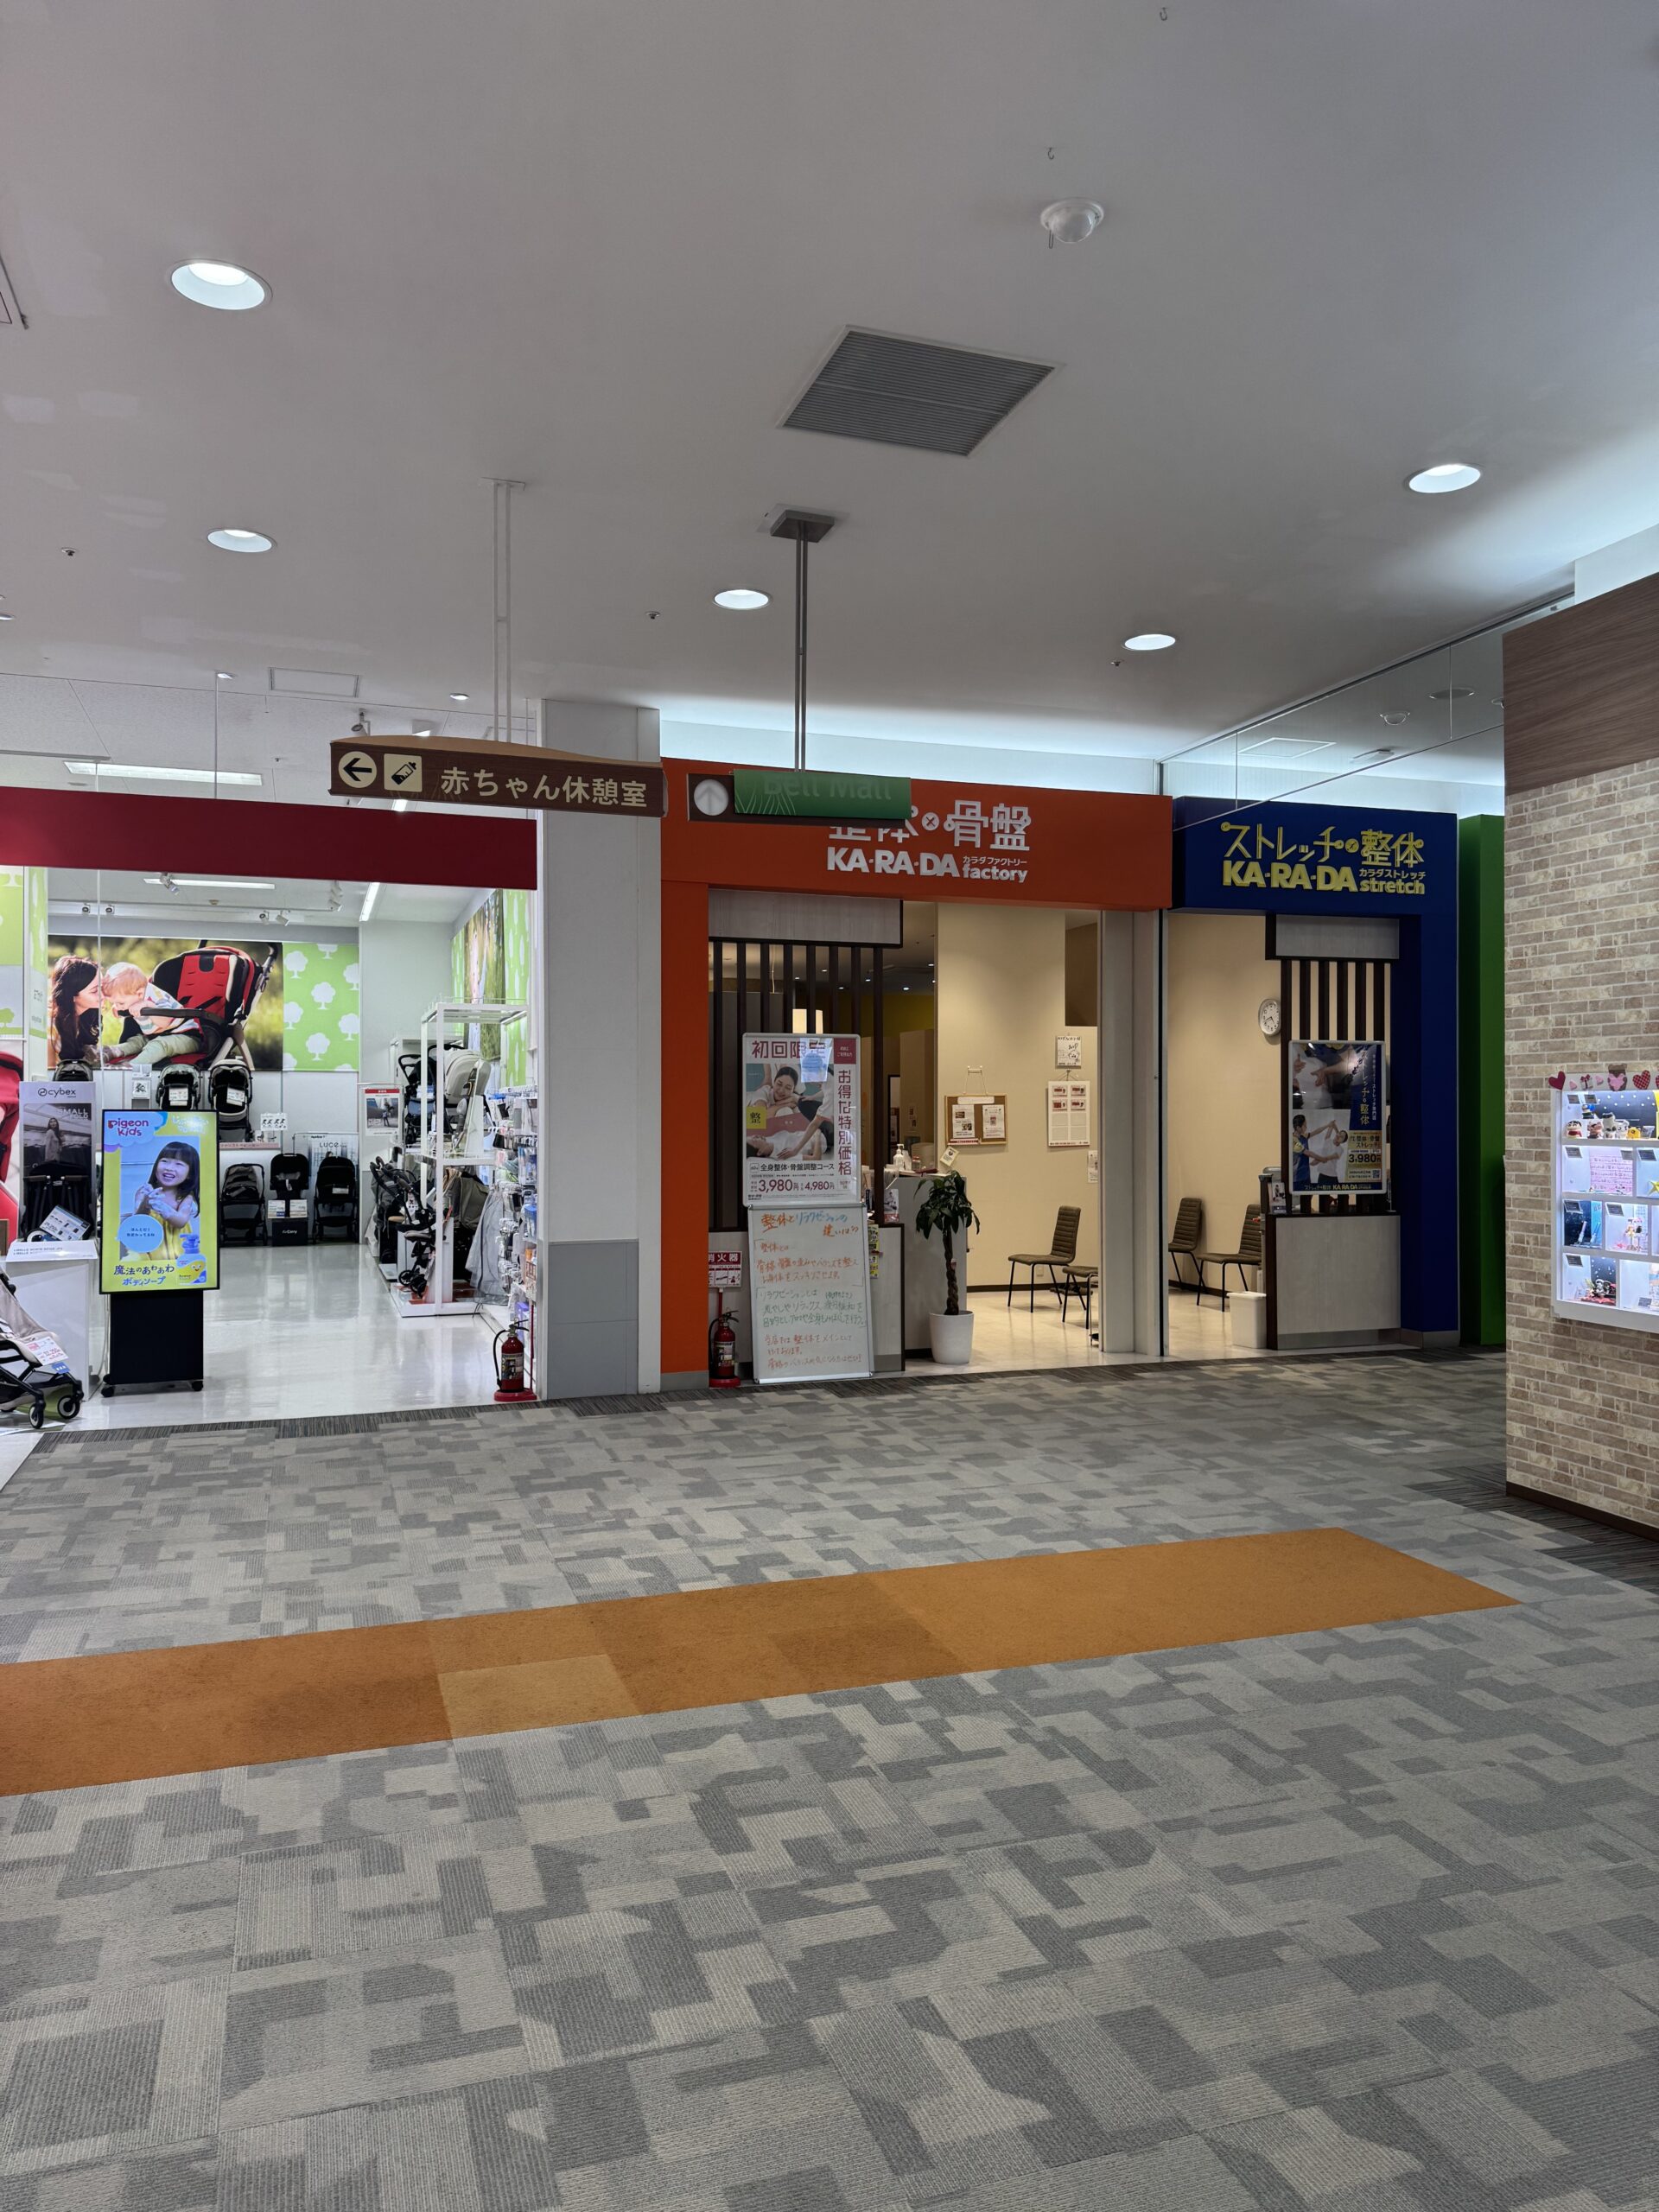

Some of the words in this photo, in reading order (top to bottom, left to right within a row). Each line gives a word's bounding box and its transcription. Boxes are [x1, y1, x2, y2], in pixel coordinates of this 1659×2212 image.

[441, 766, 647, 808] 赤ちゃん休憩室
[830, 776, 892, 800] Mall
[963, 855, 1027, 866] カラダファクトリー
[963, 864, 1028, 883] factory
[1358, 868, 1426, 879] カラダストレッチ
[1359, 878, 1426, 895] stretch
[48, 1088, 76, 1098] cybex
[108, 1118, 149, 1128] pigeon
[837, 1070, 852, 1175] お得な特別価格
[118, 1127, 142, 1136] kids
[122, 1276, 166, 1287] ボディソープ
